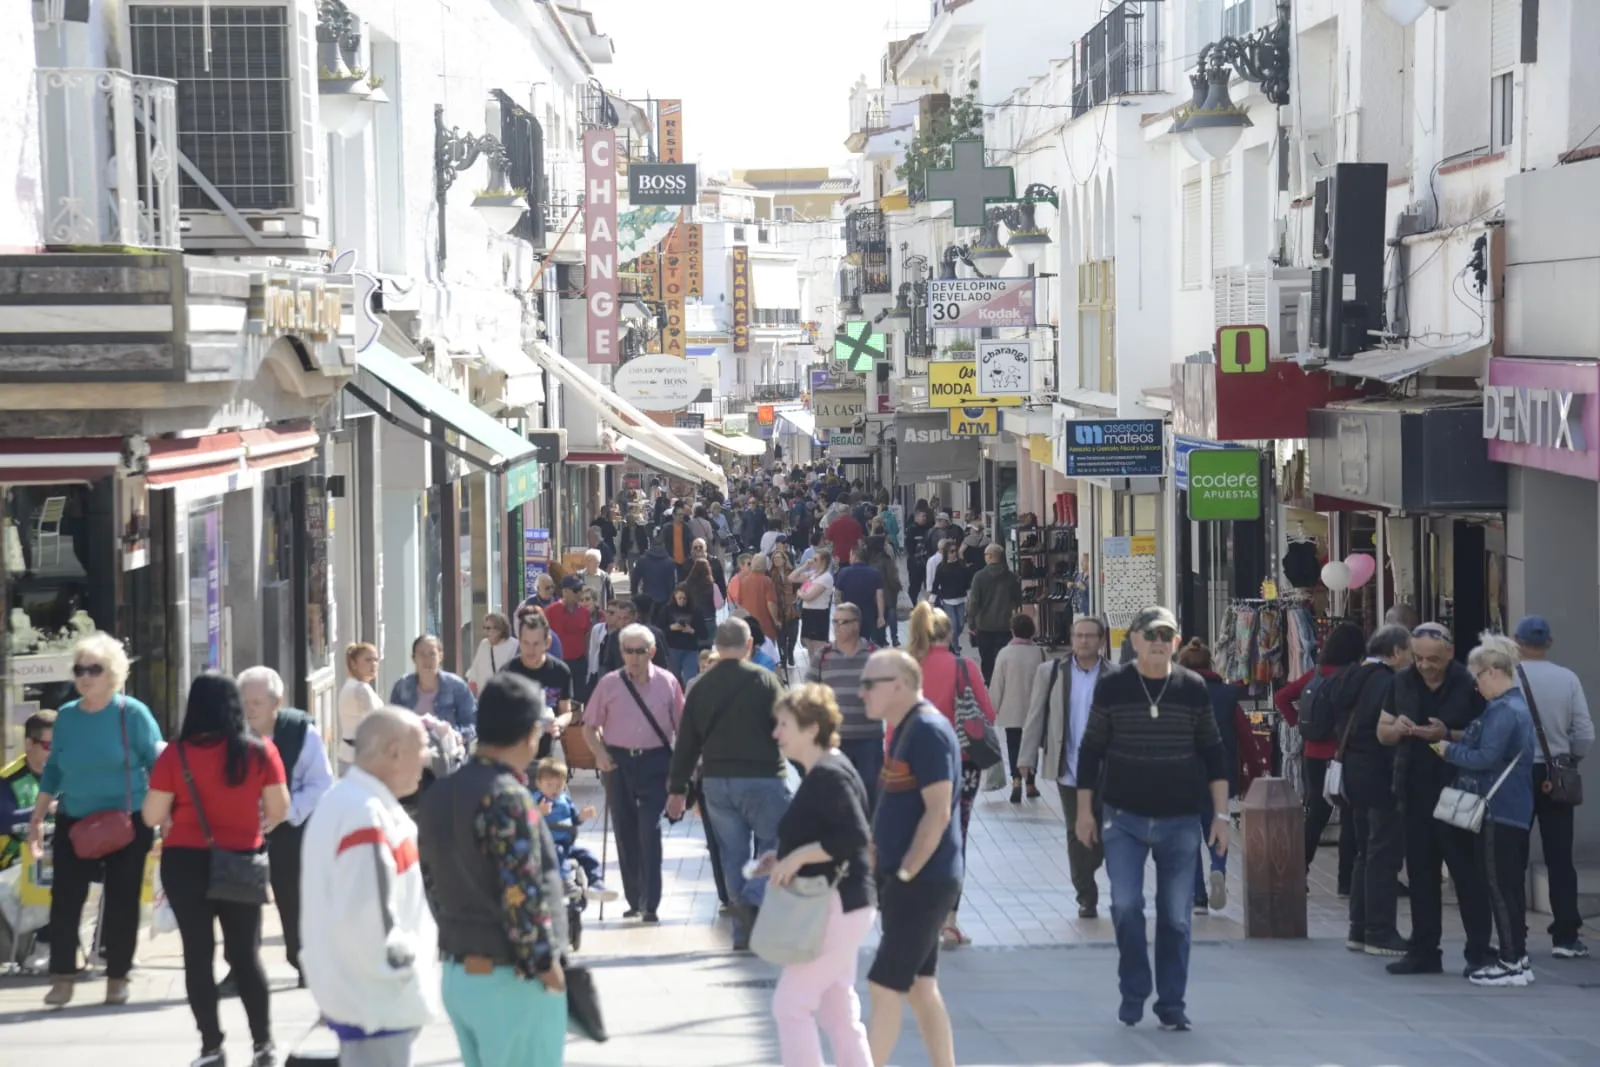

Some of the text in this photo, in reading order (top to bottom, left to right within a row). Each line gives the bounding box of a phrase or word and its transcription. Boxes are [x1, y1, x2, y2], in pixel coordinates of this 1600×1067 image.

[638, 174, 688, 190] BOSS
[591, 140, 614, 354] CHANGE
[688, 225, 700, 294] ARROCERIA
[932, 281, 1007, 292] DEVELOPING
[932, 292, 992, 302] REVELADO
[735, 264, 747, 347] TABACOS
[933, 303, 961, 320] 30
[979, 307, 1021, 319] Kodak
[982, 347, 1028, 364] Charanga
[932, 383, 973, 396] MODA
[1482, 385, 1574, 452] DENTIX
[957, 422, 990, 434] ATM
[831, 435, 864, 446] REGALO
[1104, 431, 1154, 445] mateos
[1192, 472, 1258, 488] codere
[1203, 490, 1258, 499] APUESTAS
